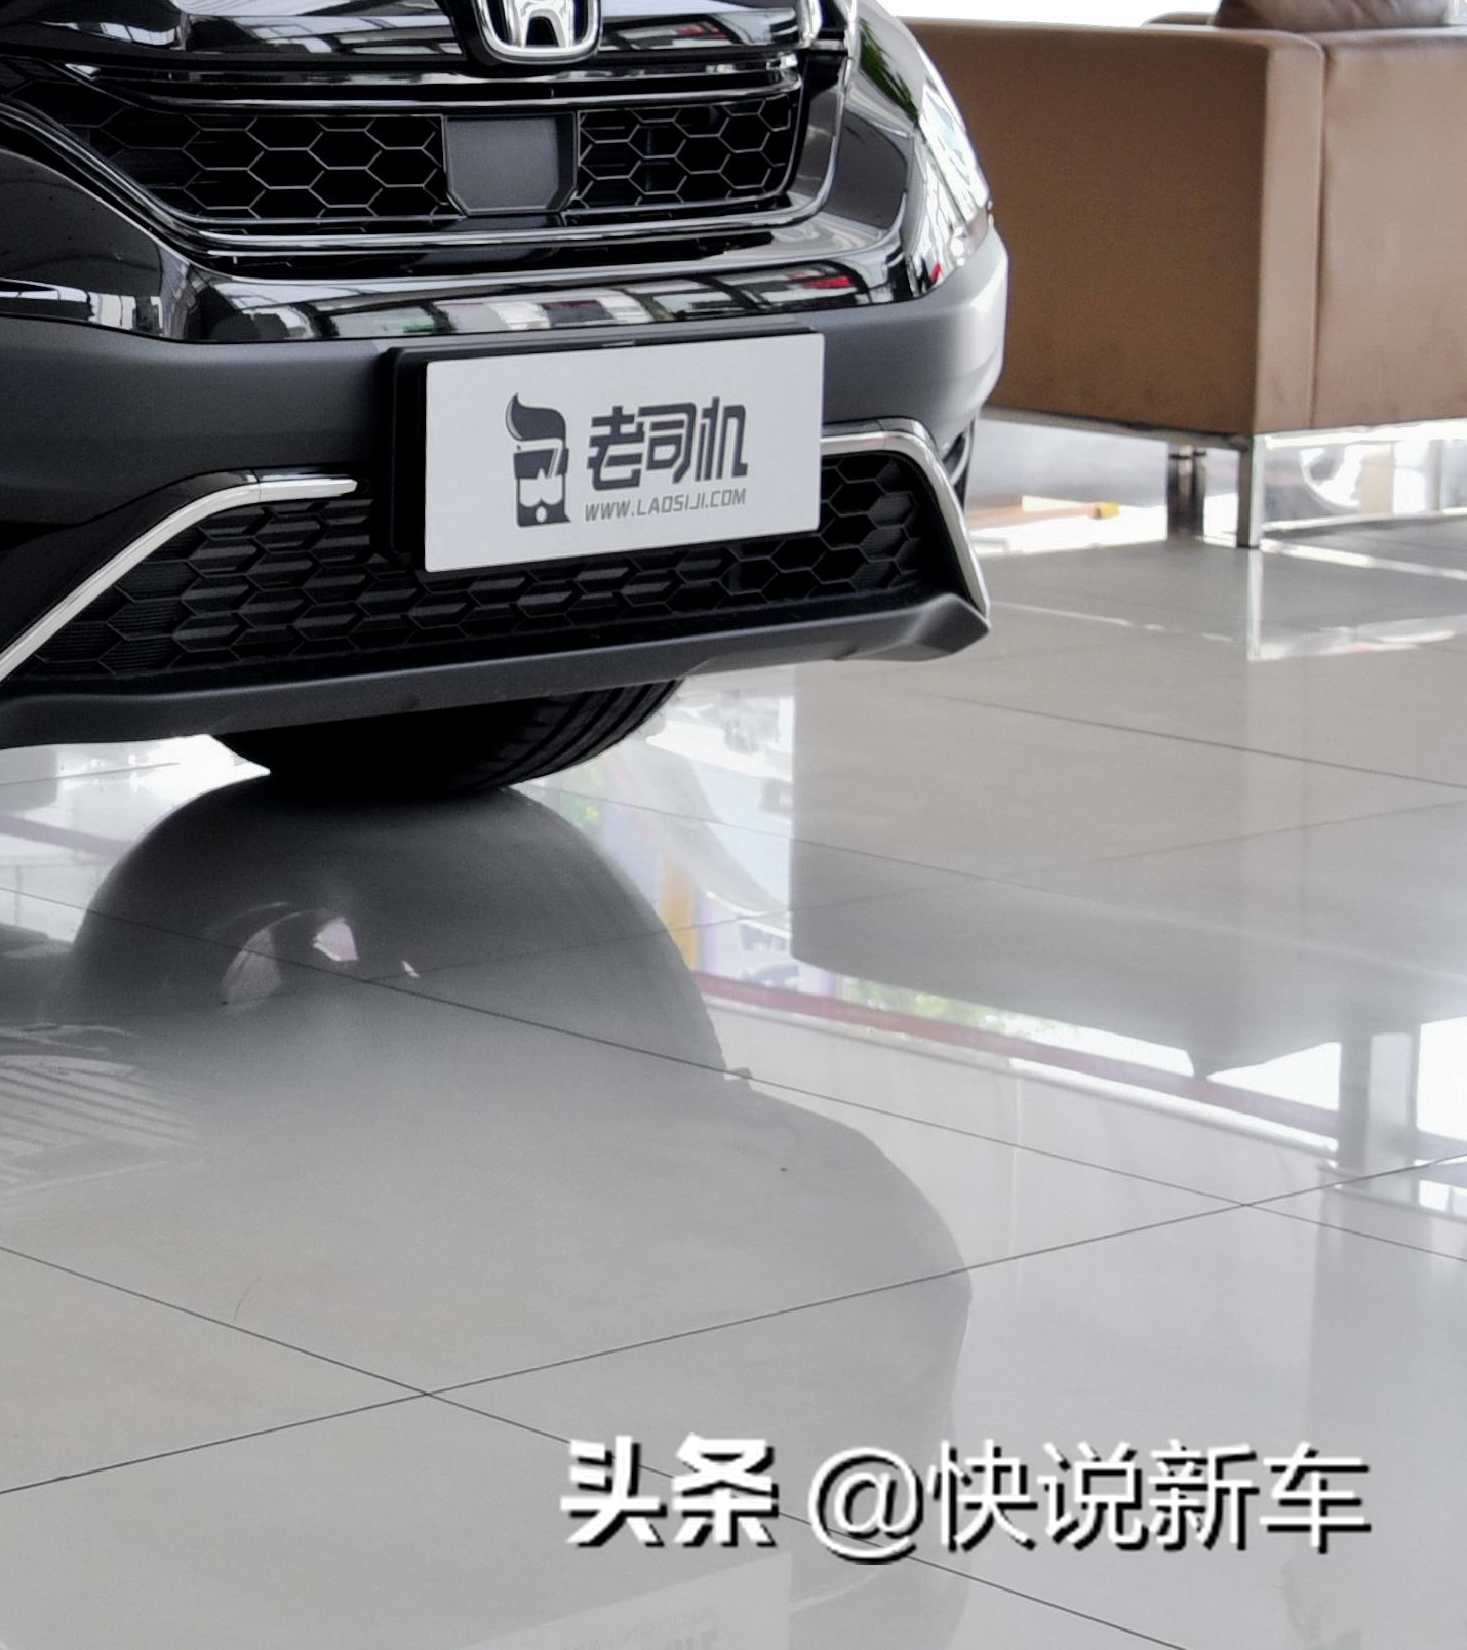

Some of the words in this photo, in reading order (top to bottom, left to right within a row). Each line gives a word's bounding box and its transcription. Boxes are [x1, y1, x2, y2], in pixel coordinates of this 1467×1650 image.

[587, 395, 749, 492] 老司机
[584, 487, 747, 523] WWW.LAOSIJI.COM
